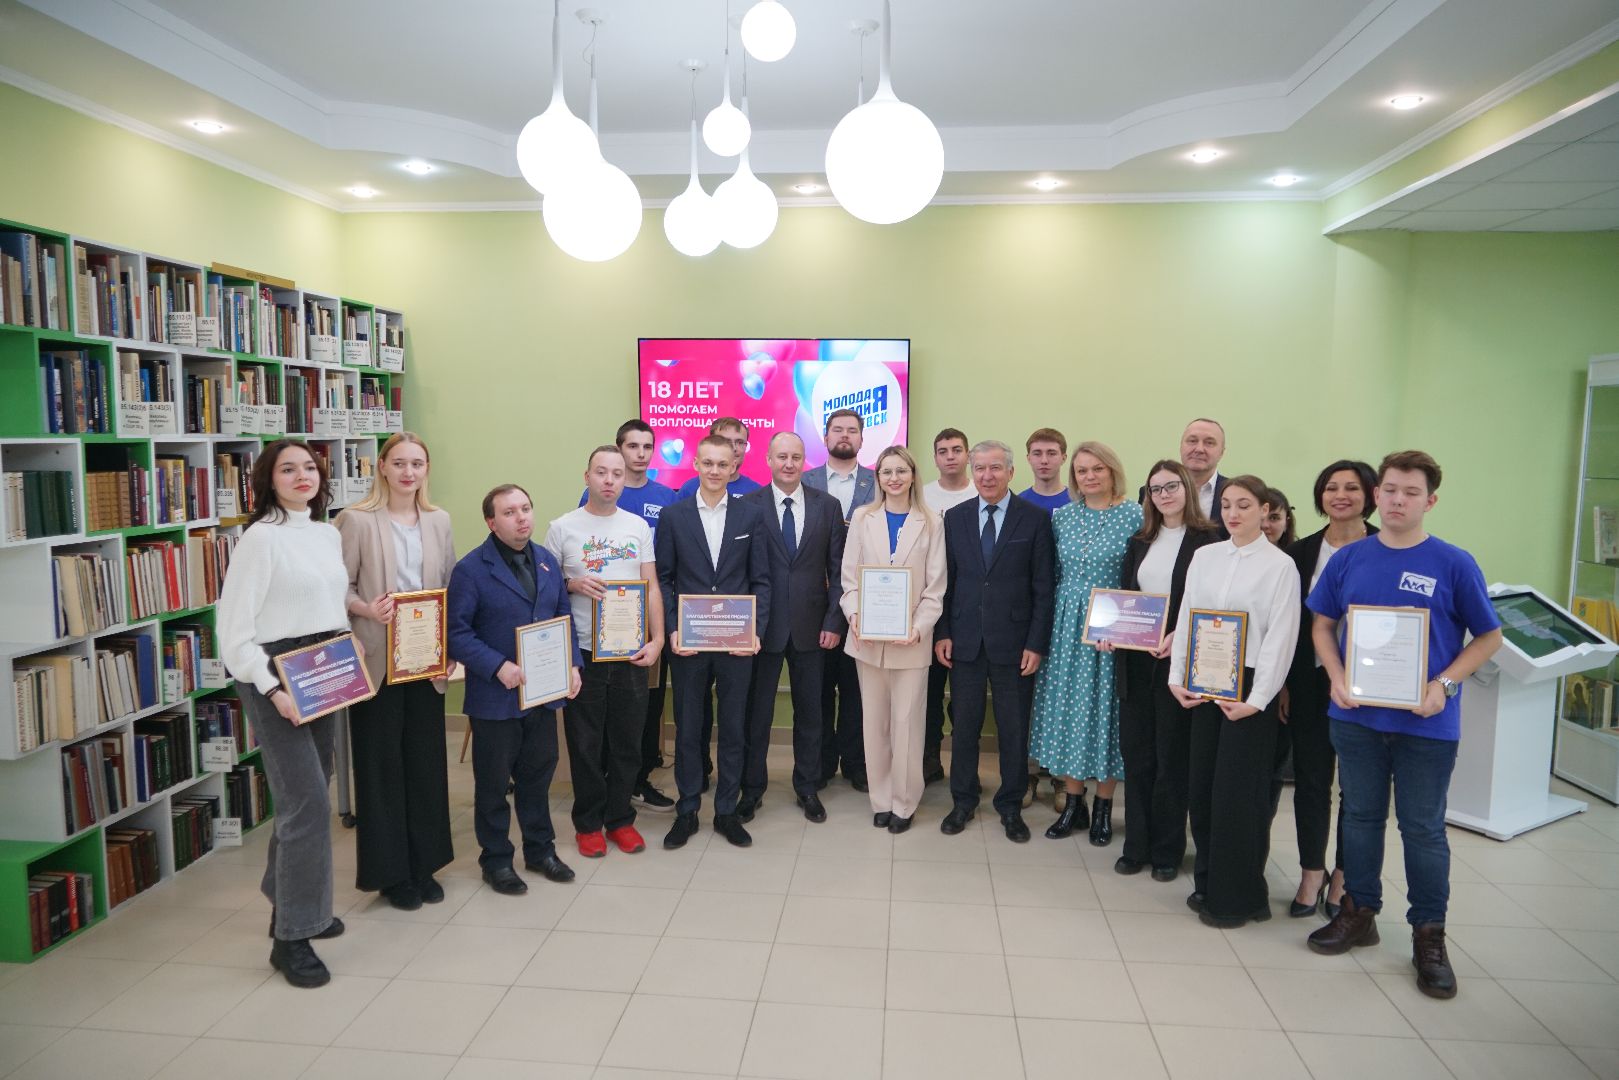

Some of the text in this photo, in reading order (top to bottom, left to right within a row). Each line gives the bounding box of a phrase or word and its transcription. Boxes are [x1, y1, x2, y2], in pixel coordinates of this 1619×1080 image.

[648, 381, 724, 399] 18 ЛЕТ
[649, 404, 718, 415] ПОМОГАЕМ
[649, 417, 775, 429] ВОПЛОЩА ЕЧТЫ
